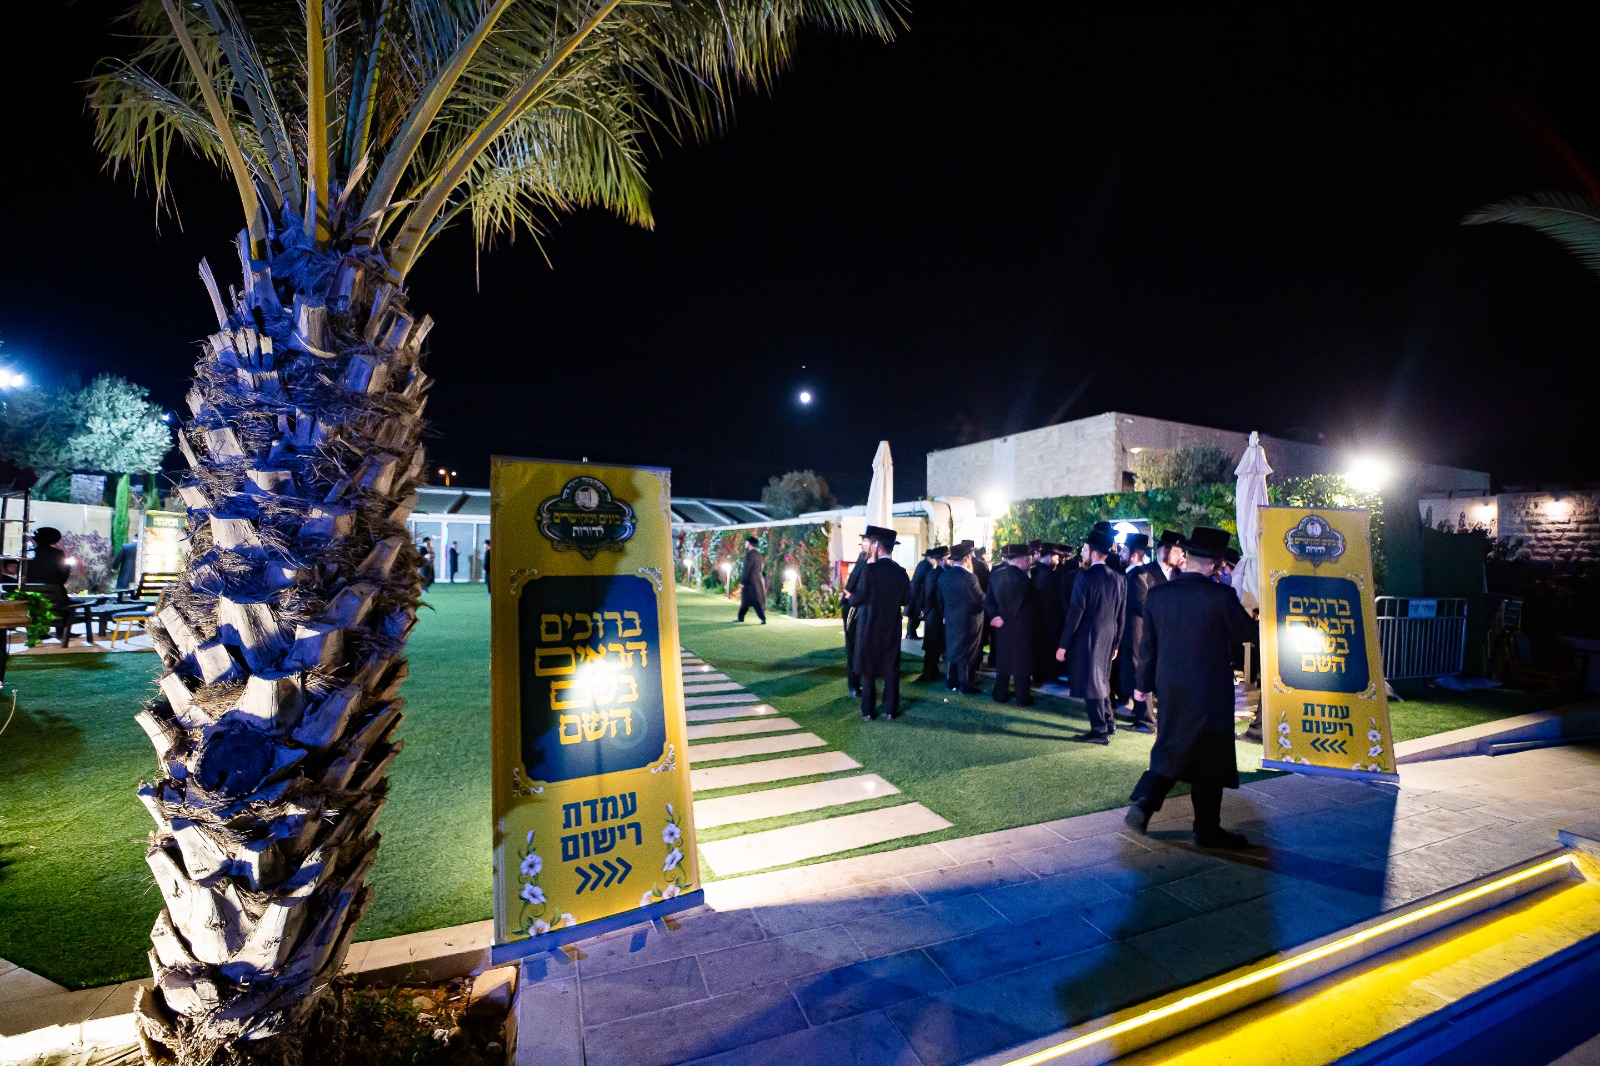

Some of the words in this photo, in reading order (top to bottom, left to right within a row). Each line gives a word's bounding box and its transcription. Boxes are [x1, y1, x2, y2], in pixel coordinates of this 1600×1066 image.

[572, 525, 605, 538] לדורות
[1289, 596, 1351, 616] ברוכים
[540, 609, 642, 642] ברוכים
[1285, 615, 1355, 635] הבאים
[535, 640, 648, 676] הבאים
[1301, 654, 1346, 674] השם
[550, 672, 639, 711] בשם
[1303, 702, 1350, 719] עמדת
[559, 706, 632, 745] השם
[1301, 718, 1354, 737] רישום
[562, 791, 638, 830] עמדת
[560, 821, 643, 863] רישום
